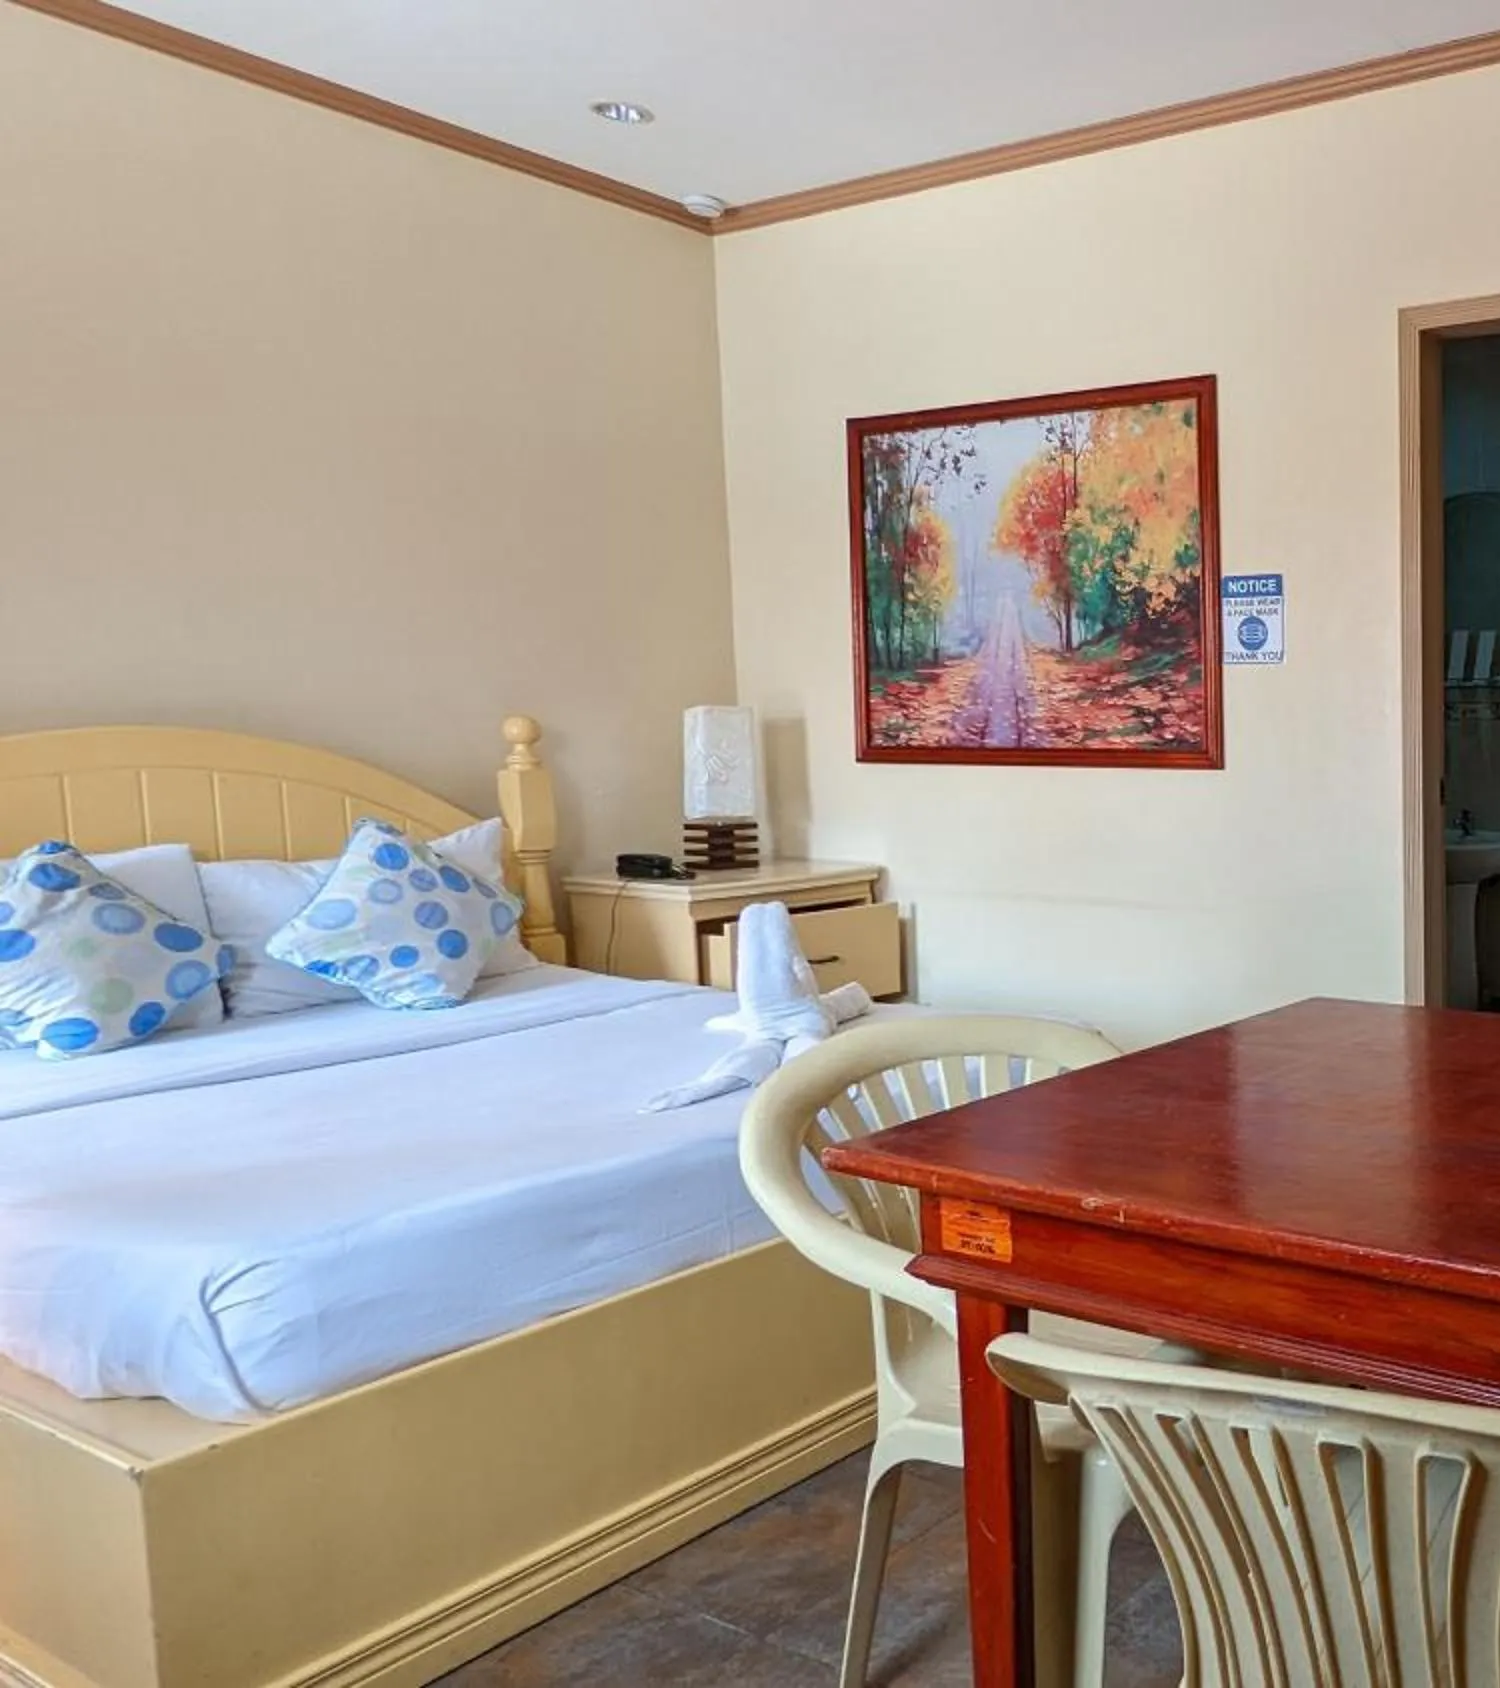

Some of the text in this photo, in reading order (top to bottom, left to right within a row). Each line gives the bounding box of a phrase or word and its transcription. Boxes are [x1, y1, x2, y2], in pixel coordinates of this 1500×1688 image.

[1228, 579, 1277, 593] NOTICE
[1225, 650, 1281, 660] THANK YOU
